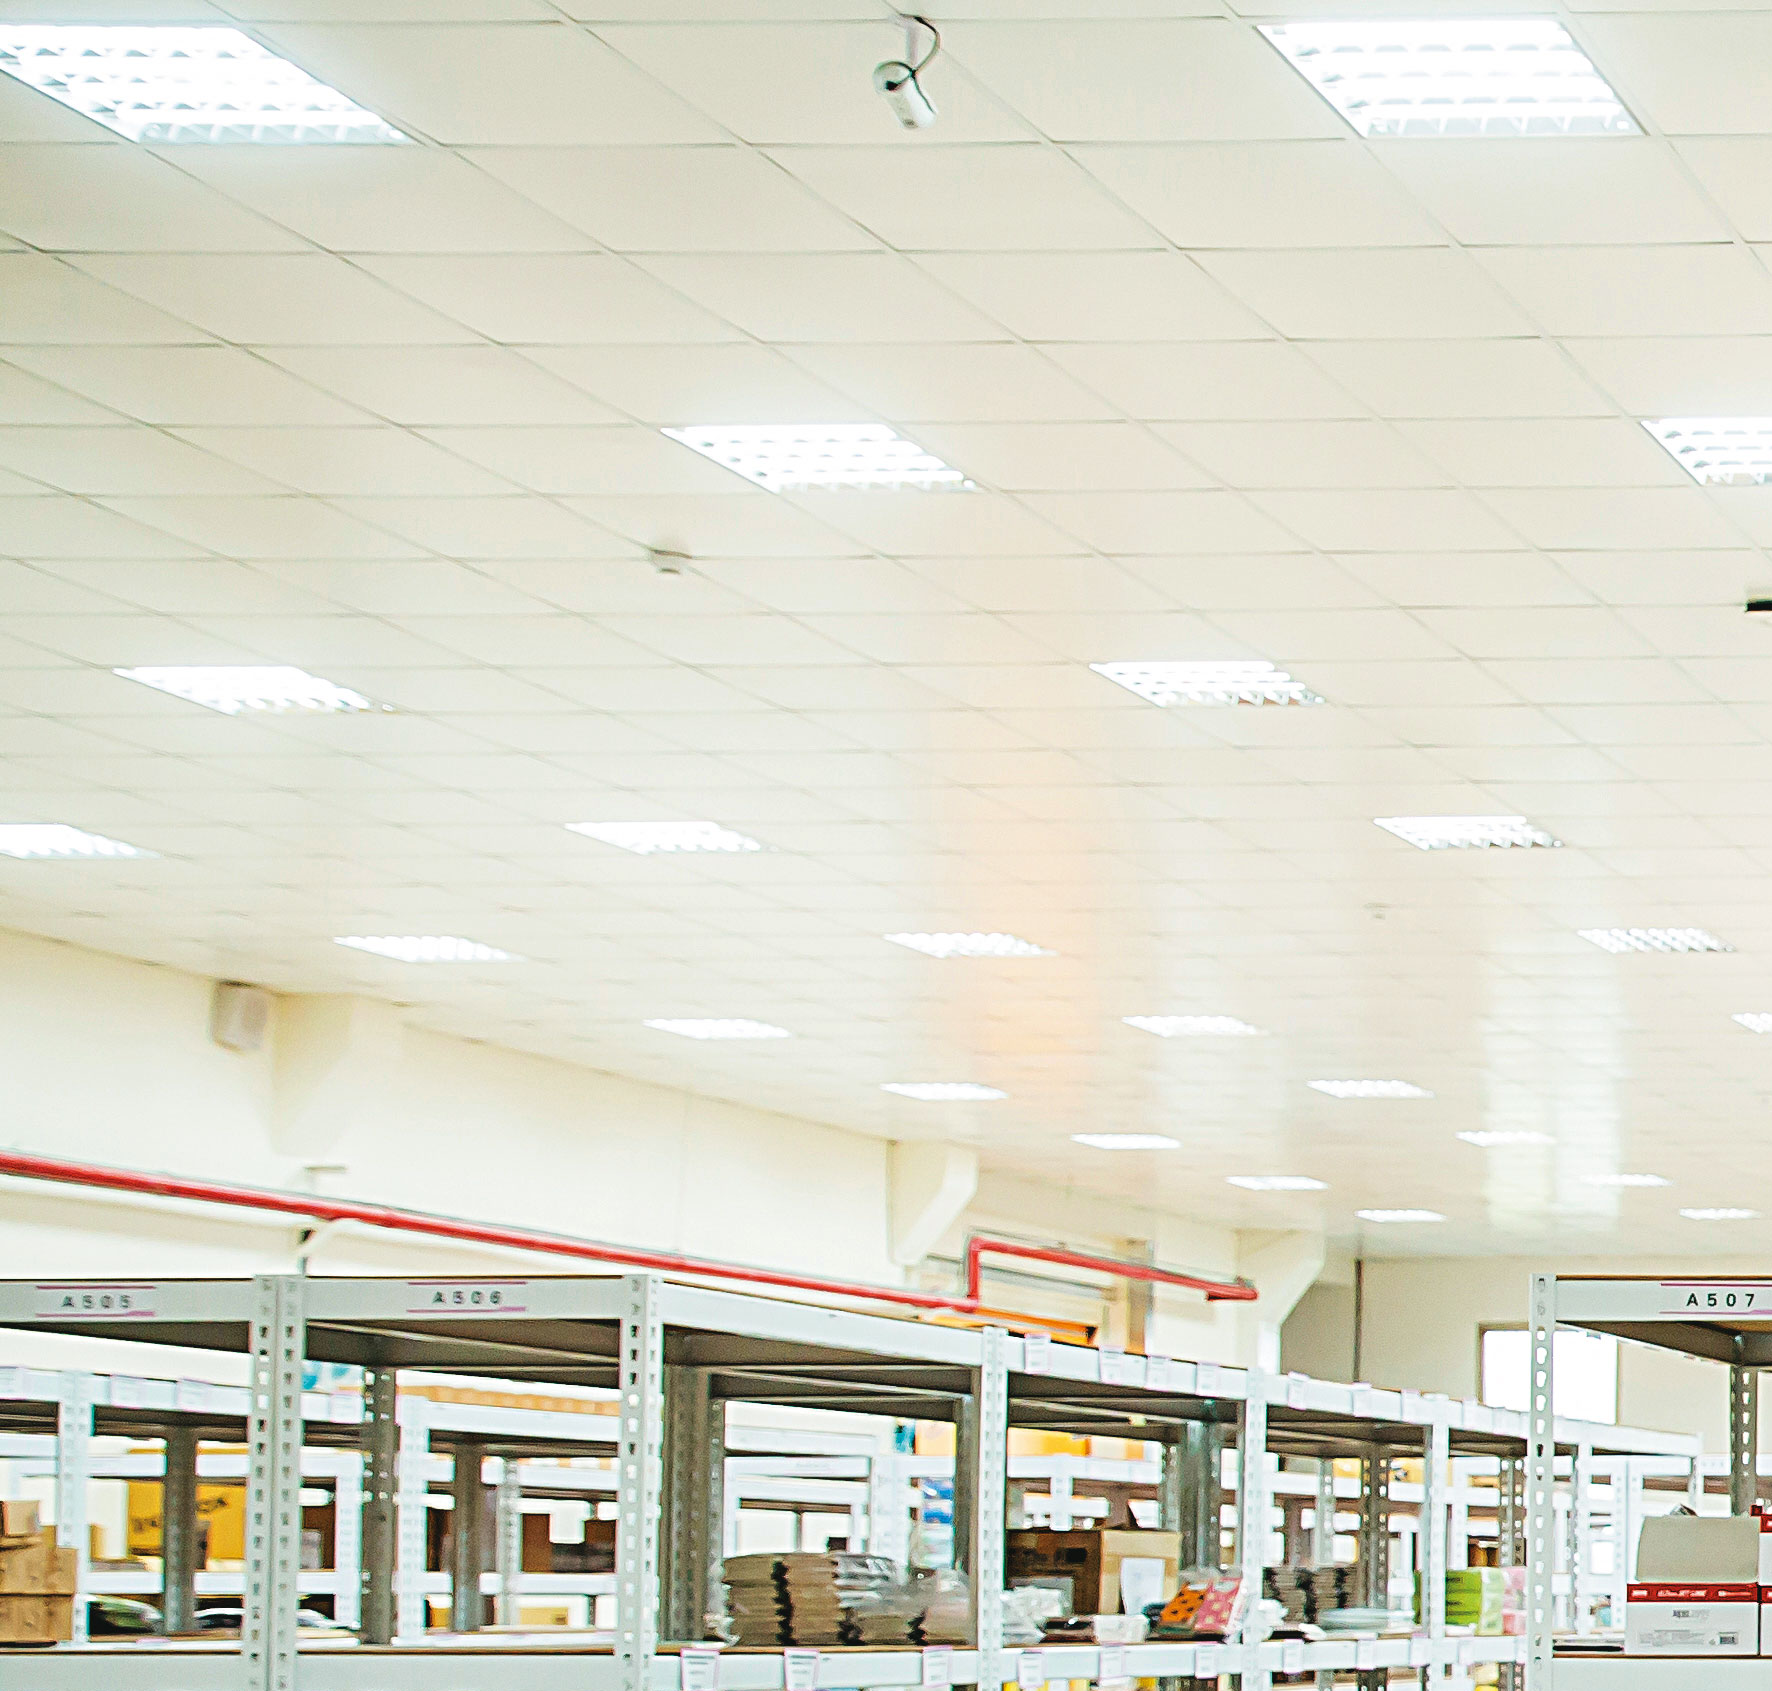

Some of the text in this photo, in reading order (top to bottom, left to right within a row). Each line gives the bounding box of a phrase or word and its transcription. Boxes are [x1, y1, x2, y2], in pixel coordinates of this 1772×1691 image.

[60, 1294, 133, 1309] A505
[432, 1289, 503, 1305] A506
[1686, 1293, 1756, 1308] A507
